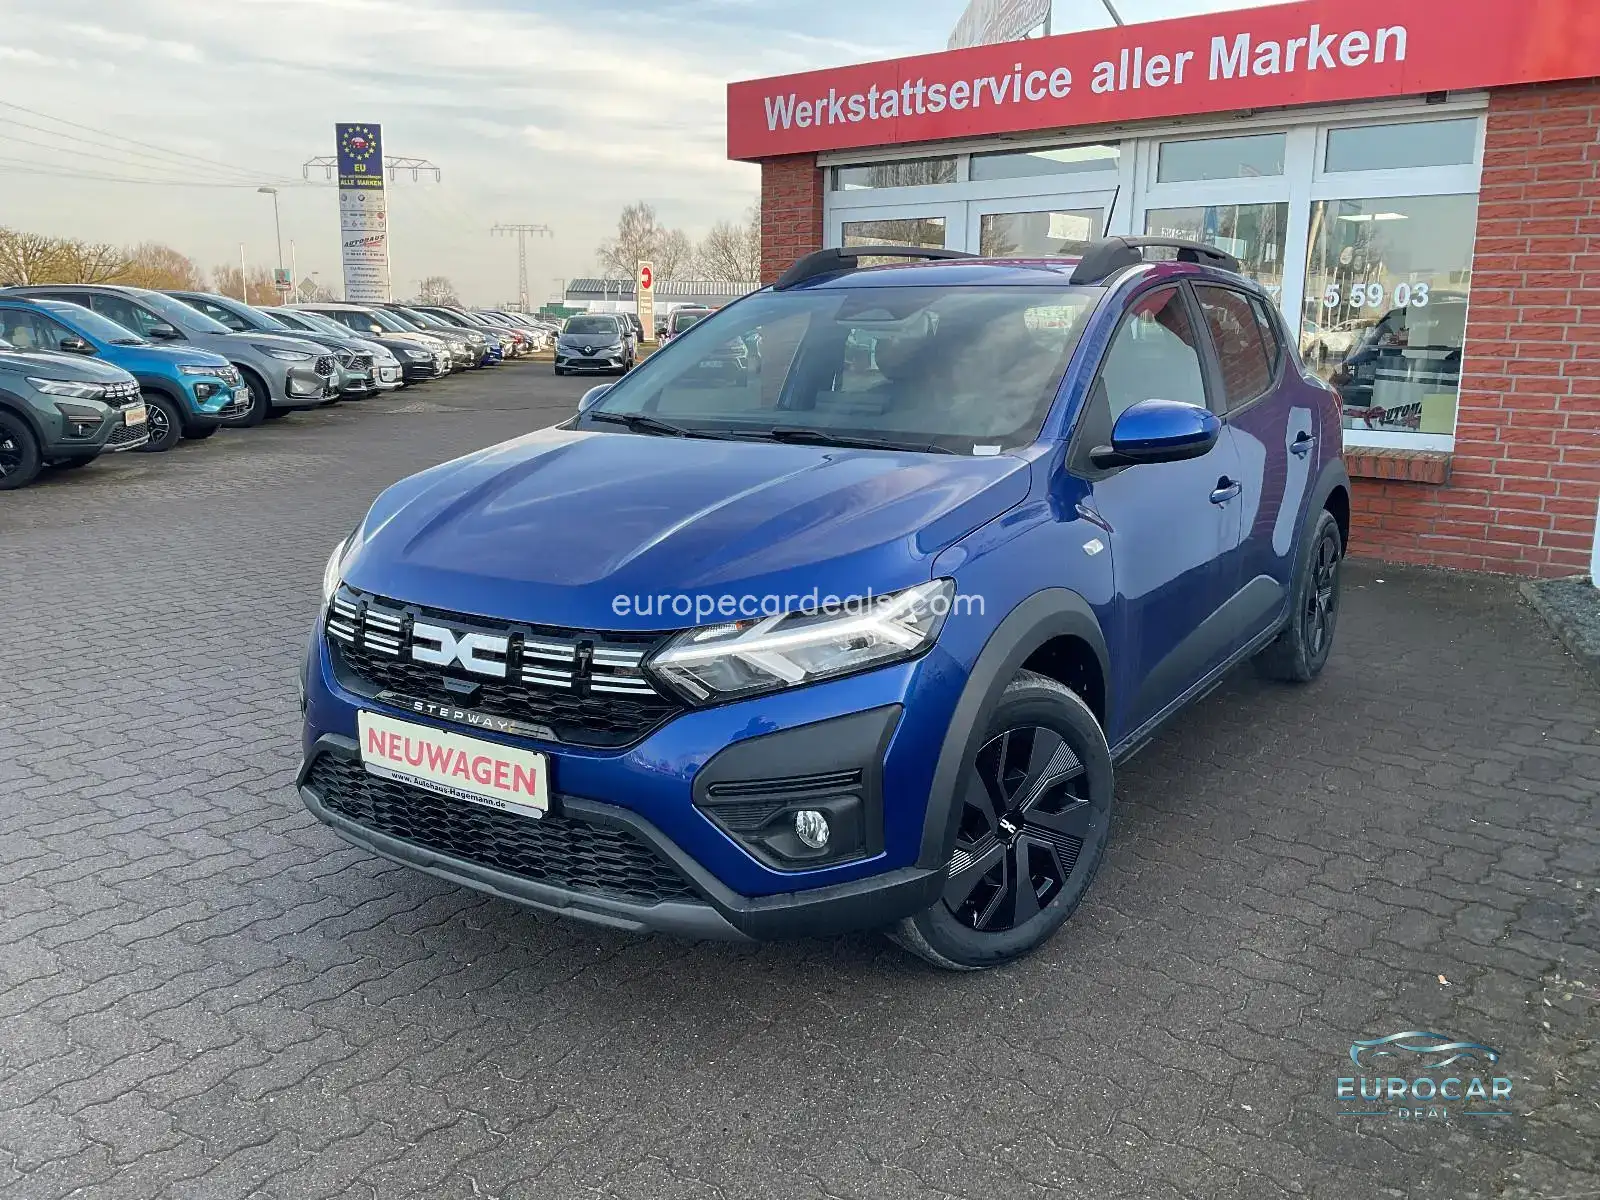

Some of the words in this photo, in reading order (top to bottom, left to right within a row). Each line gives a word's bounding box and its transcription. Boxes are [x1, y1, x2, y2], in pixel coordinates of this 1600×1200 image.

[764, 63, 1073, 131] Werkstattservice
[1091, 47, 1194, 94] aller
[1208, 24, 1408, 81] Marken
[354, 163, 367, 172] EU
[1350, 282, 1384, 308] 59
[1394, 282, 1429, 308] 03
[413, 701, 508, 731] STEPWAY
[367, 727, 537, 796] NEUWAGEN
